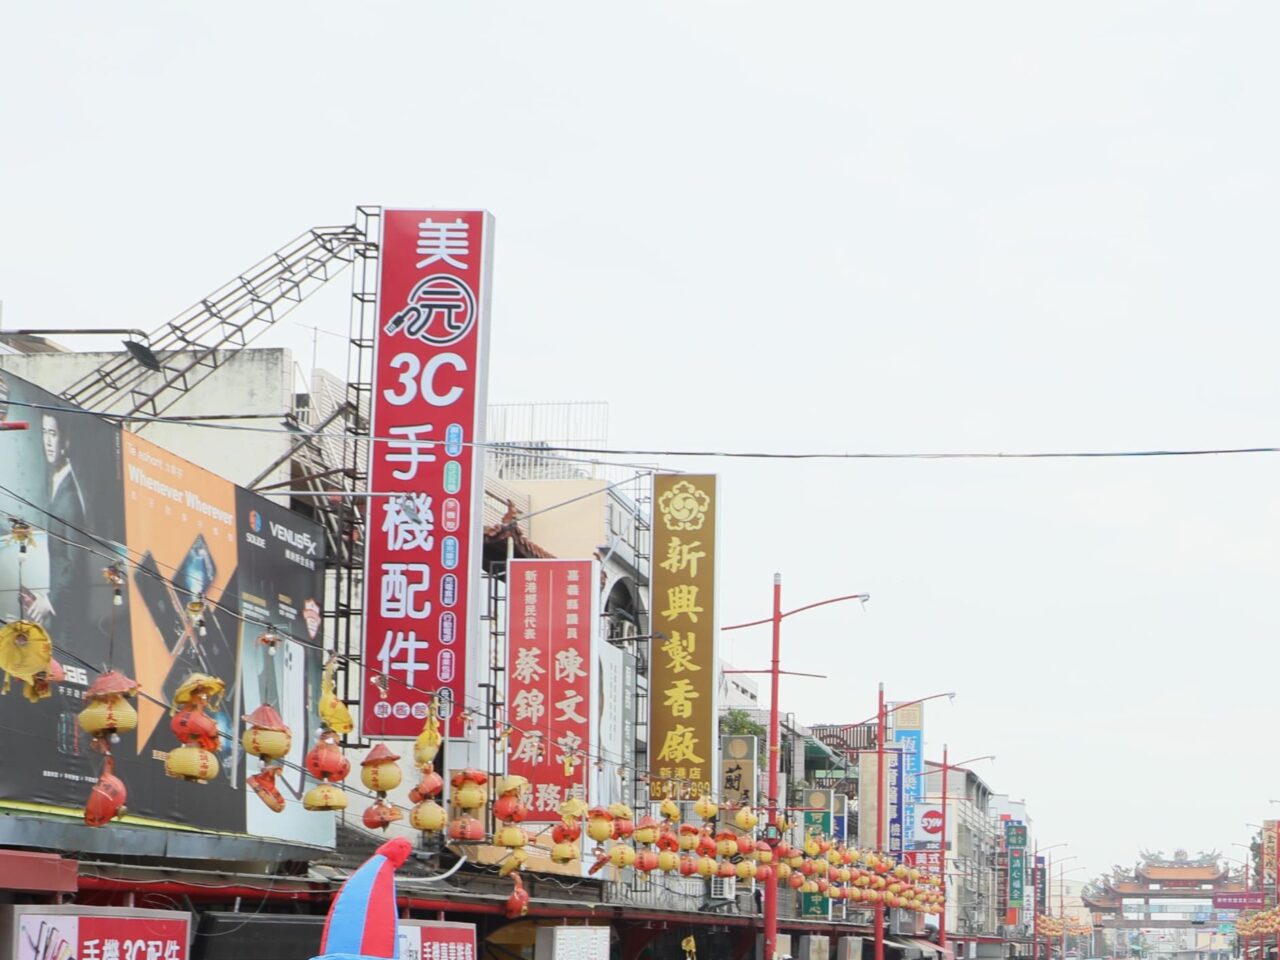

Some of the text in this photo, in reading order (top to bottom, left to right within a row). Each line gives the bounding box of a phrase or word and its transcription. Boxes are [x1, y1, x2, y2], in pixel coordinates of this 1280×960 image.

[383, 352, 468, 407] 3C
[128, 463, 233, 526] Whenever Wherever
[377, 424, 437, 690] 手機配件
[566, 570, 580, 639] 嘉義縣議員
[657, 536, 706, 764] 新興製香廠
